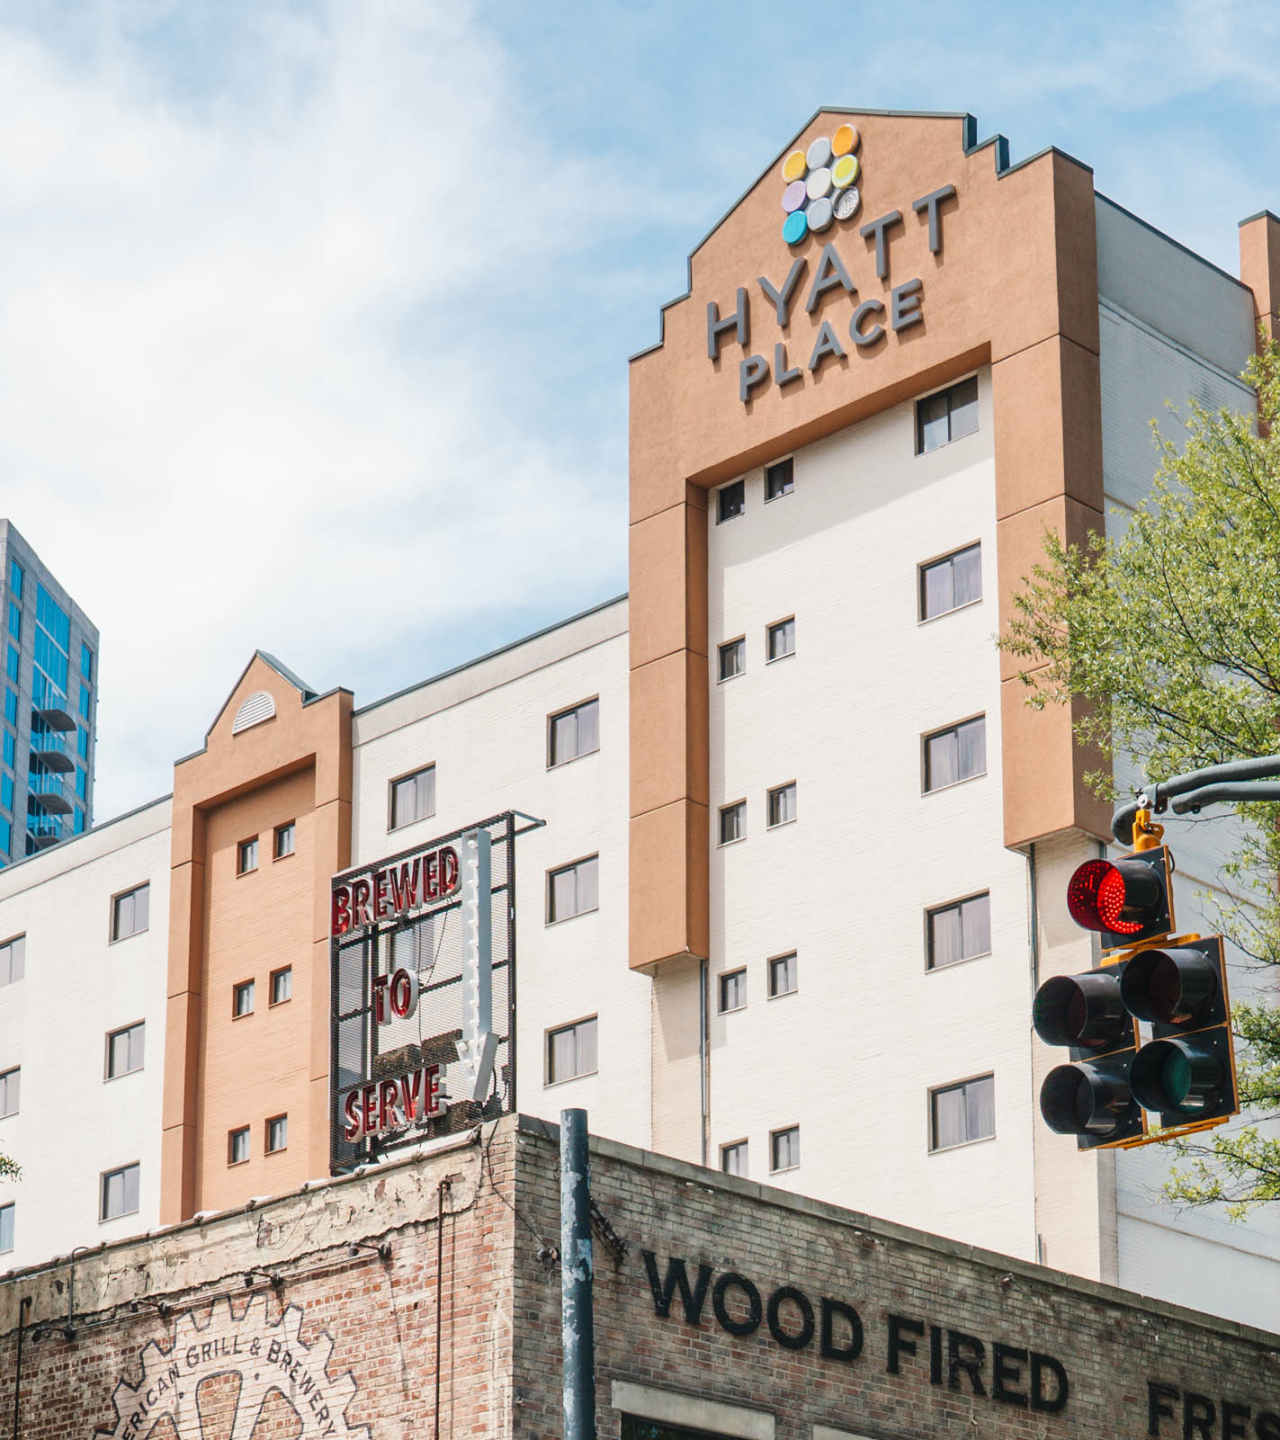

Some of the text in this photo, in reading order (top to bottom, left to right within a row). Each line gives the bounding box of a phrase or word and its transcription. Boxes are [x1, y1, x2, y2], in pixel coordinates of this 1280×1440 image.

[706, 183, 956, 361] HYATT
[739, 278, 923, 404] PLACE
[331, 845, 462, 937] BREWED
[372, 967, 419, 1026] TO
[345, 1063, 448, 1143] SERVE
[643, 1250, 1070, 1414] WOOD FIRED
[185, 1334, 243, 1369] GRILL
[249, 1336, 262, 1356] &
[266, 1339, 336, 1438] BREWERY
